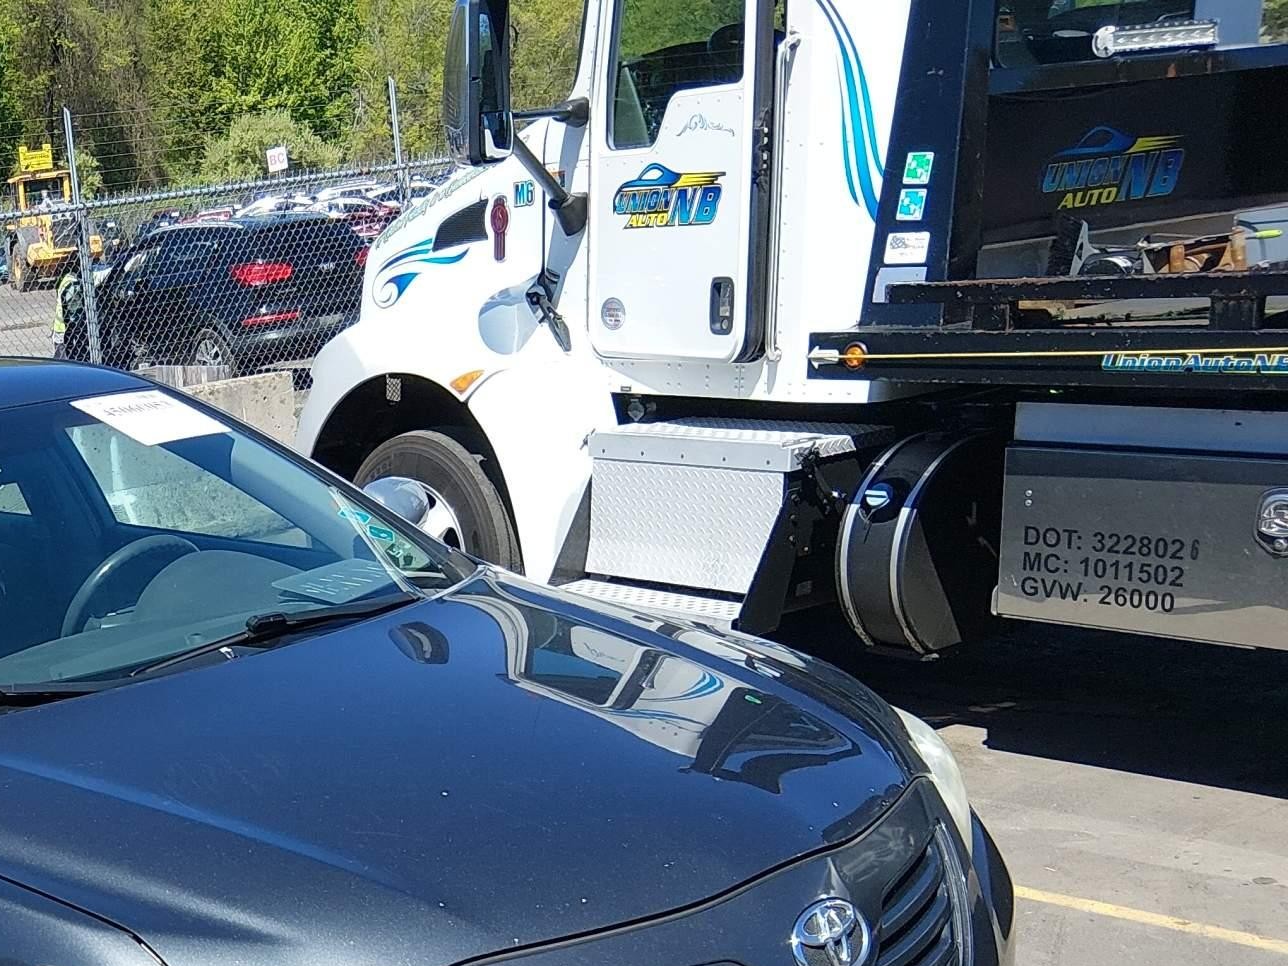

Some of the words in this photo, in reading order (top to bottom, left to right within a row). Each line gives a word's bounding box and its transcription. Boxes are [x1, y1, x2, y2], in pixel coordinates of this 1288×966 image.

[1042, 155, 1125, 193] UNION
[1115, 148, 1185, 202] NB
[514, 180, 535, 208] M6
[614, 187, 673, 215] UNION
[668, 183, 723, 227] NB
[1057, 187, 1118, 210] AUTO
[623, 213, 670, 229] AUTO
[1023, 525, 1083, 551] DOT:
[1021, 551, 1069, 574] MC:
[1079, 556, 1185, 588] 1011502
[1098, 585, 1175, 613] 26000
